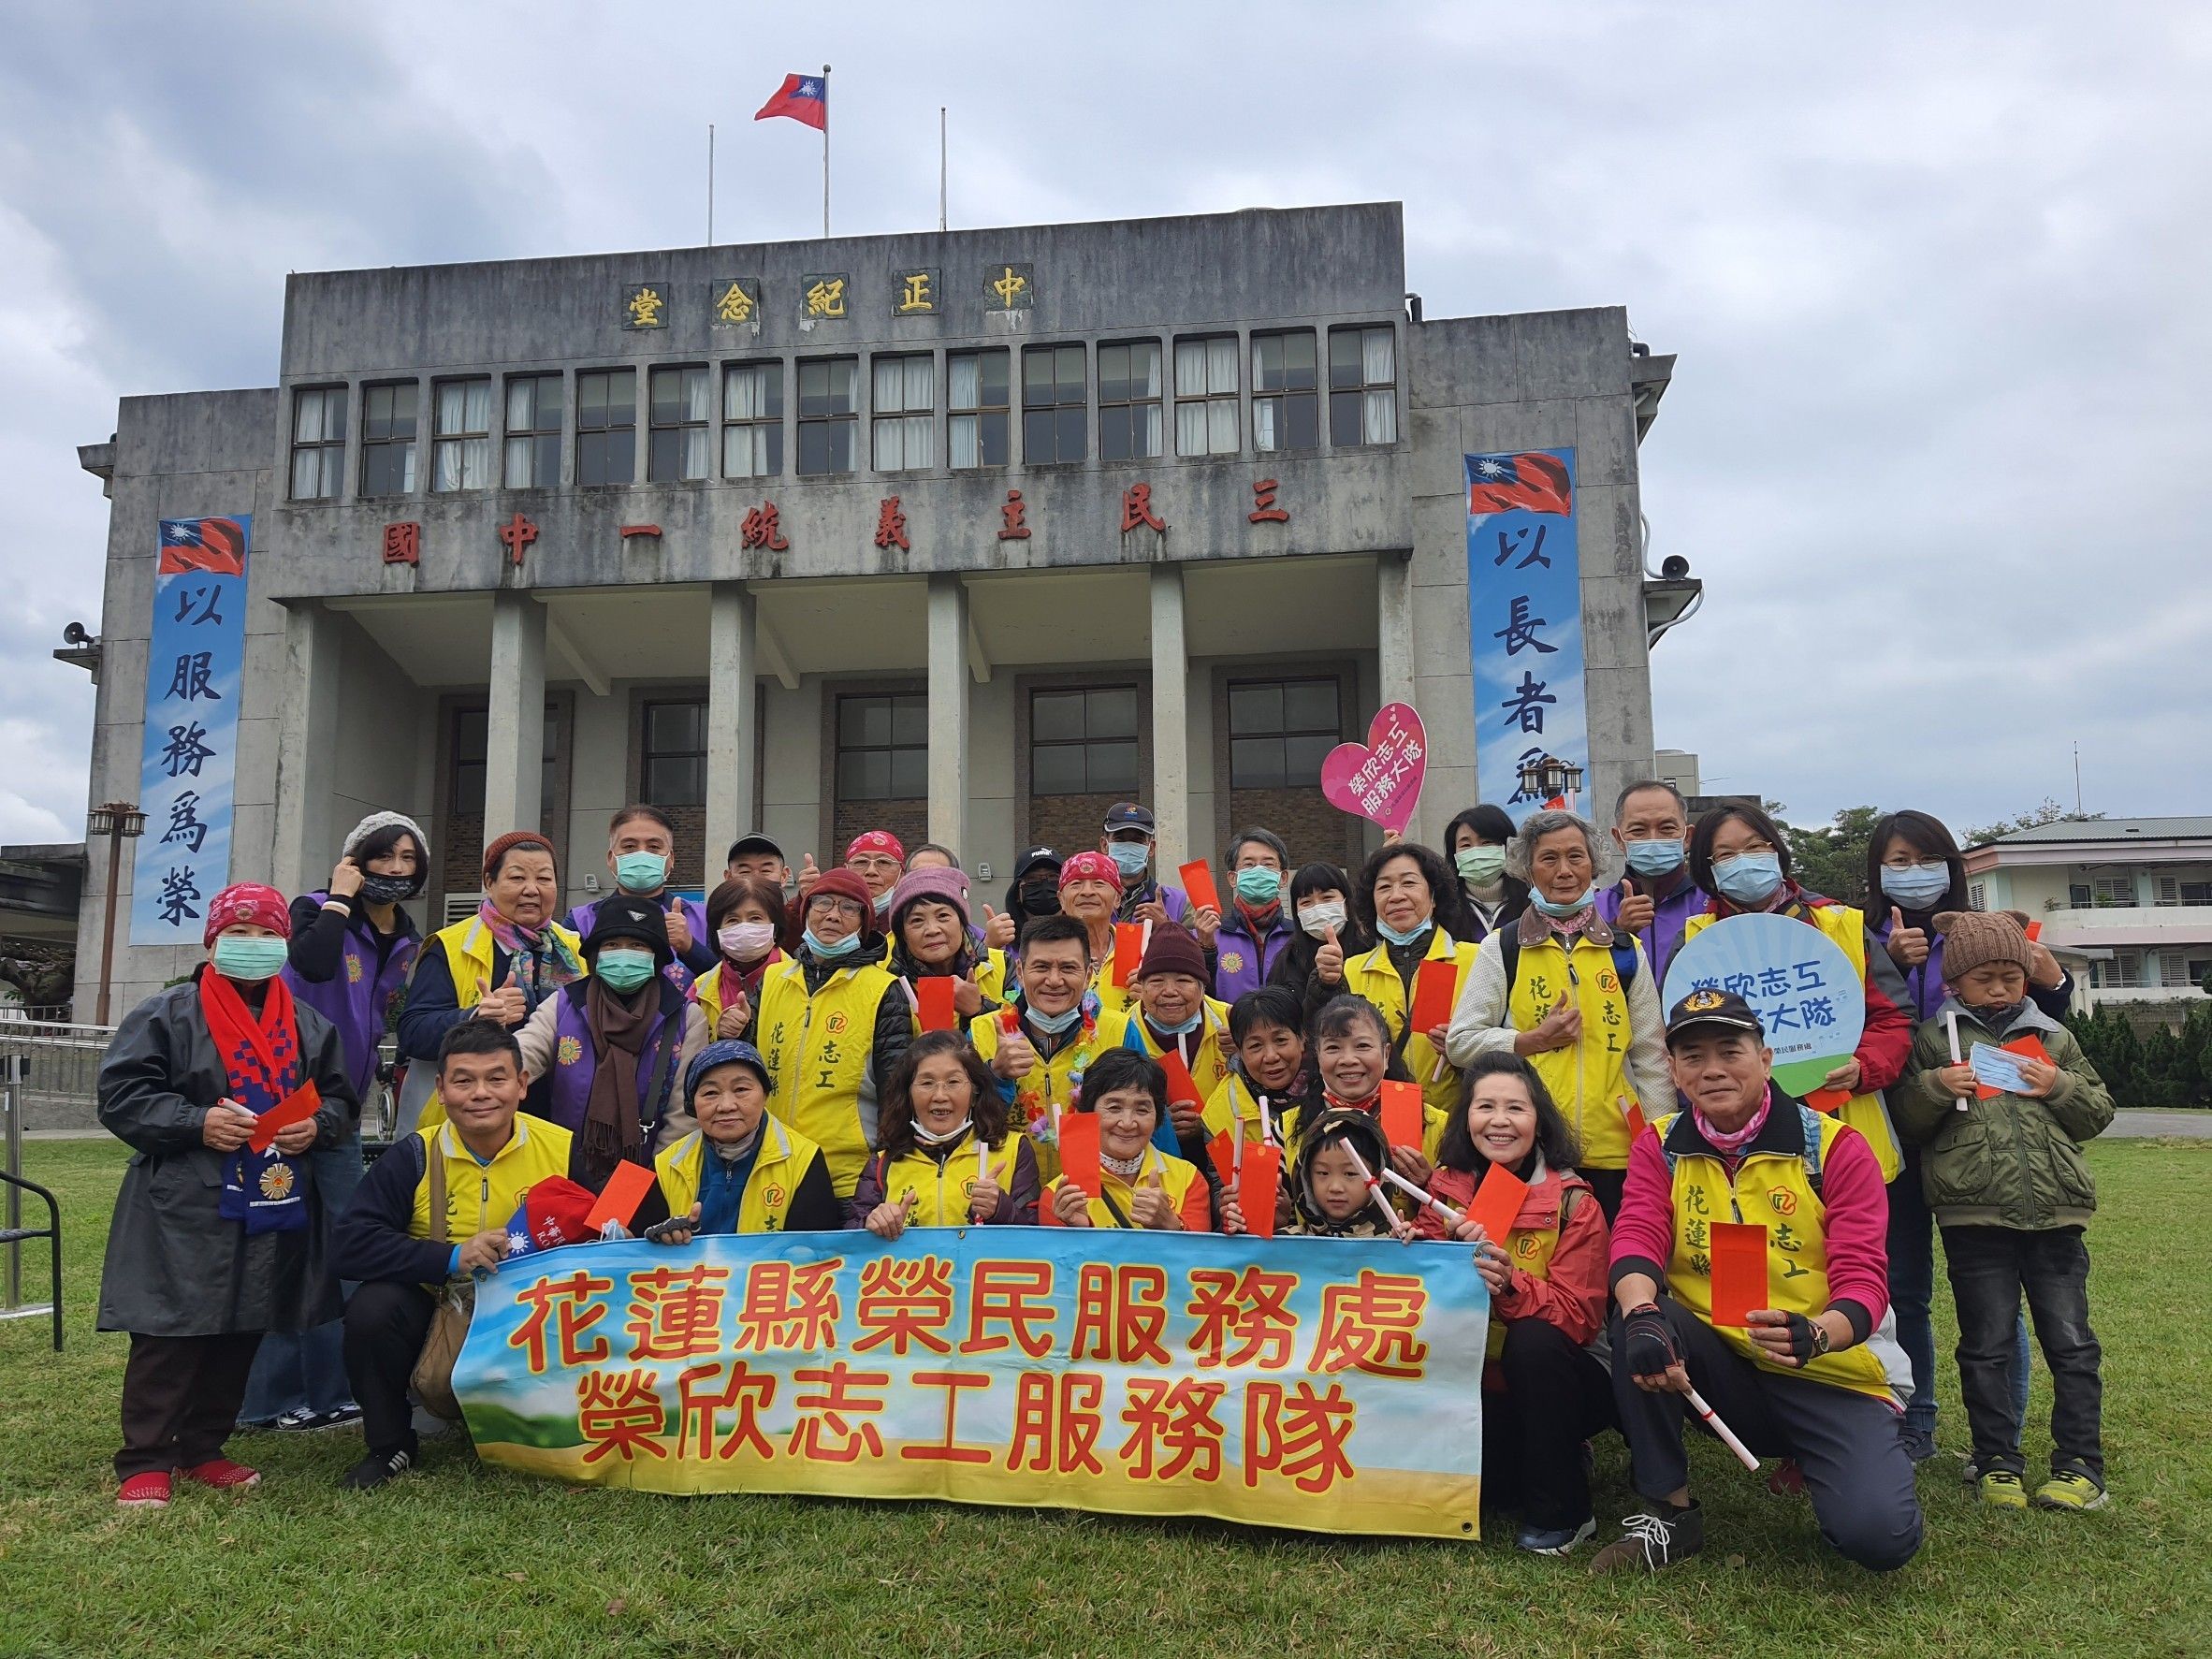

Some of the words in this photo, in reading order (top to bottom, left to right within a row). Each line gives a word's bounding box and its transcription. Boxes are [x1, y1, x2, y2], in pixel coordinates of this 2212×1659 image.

[629, 267, 1026, 326] 中正紀念堂
[383, 478, 1289, 566] 三民主義統一中國
[1361, 739, 1423, 816] 服務大隊
[1602, 1000, 1623, 1053] 志工
[1752, 996, 1836, 1034] 大隊
[816, 1041, 841, 1088] 志工
[509, 1255, 1429, 1378] 花蓮縣榮民服務處
[577, 1360, 1356, 1494] 榮欣志工服務隊
